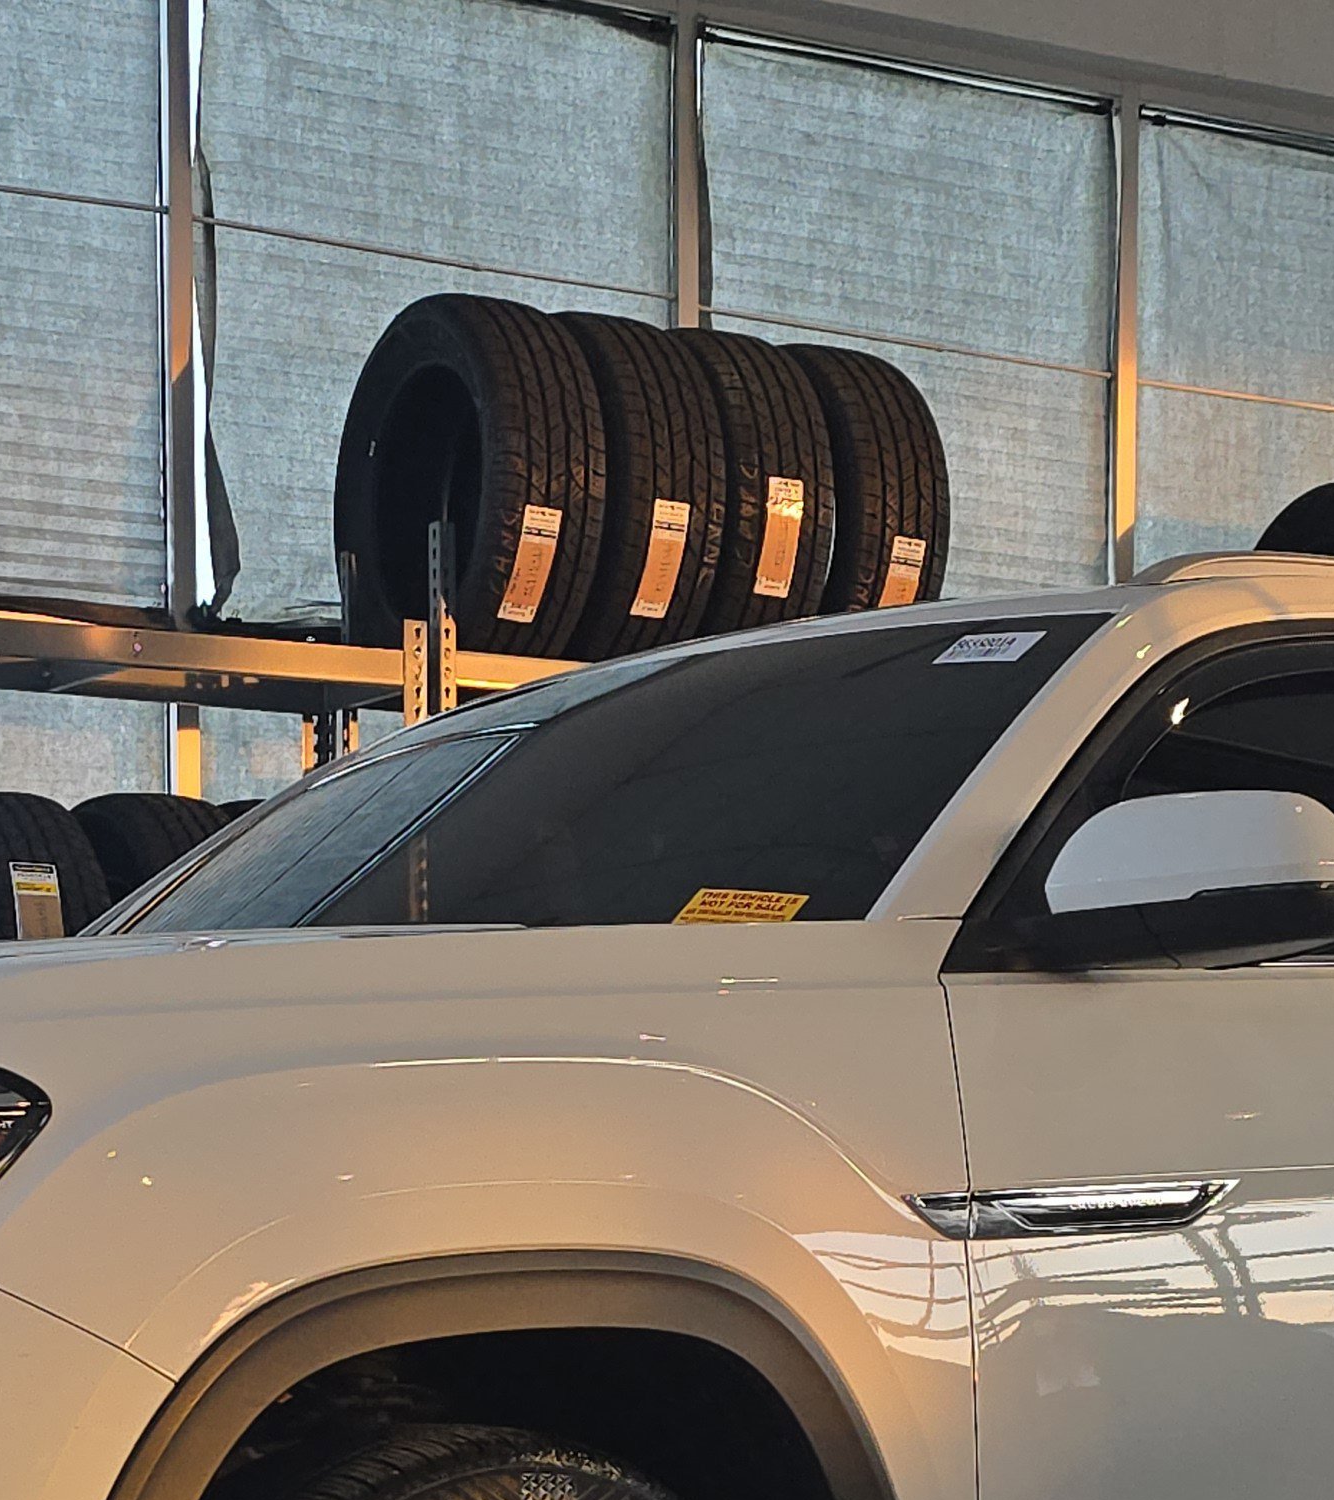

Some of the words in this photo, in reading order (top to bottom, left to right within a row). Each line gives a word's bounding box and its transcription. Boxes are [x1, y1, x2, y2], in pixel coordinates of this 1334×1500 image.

[701, 891, 728, 900] THIS
[732, 892, 783, 903] VEHICLE
[785, 897, 800, 905] IS
[727, 901, 752, 910] FOR
[754, 903, 787, 912] SALE
